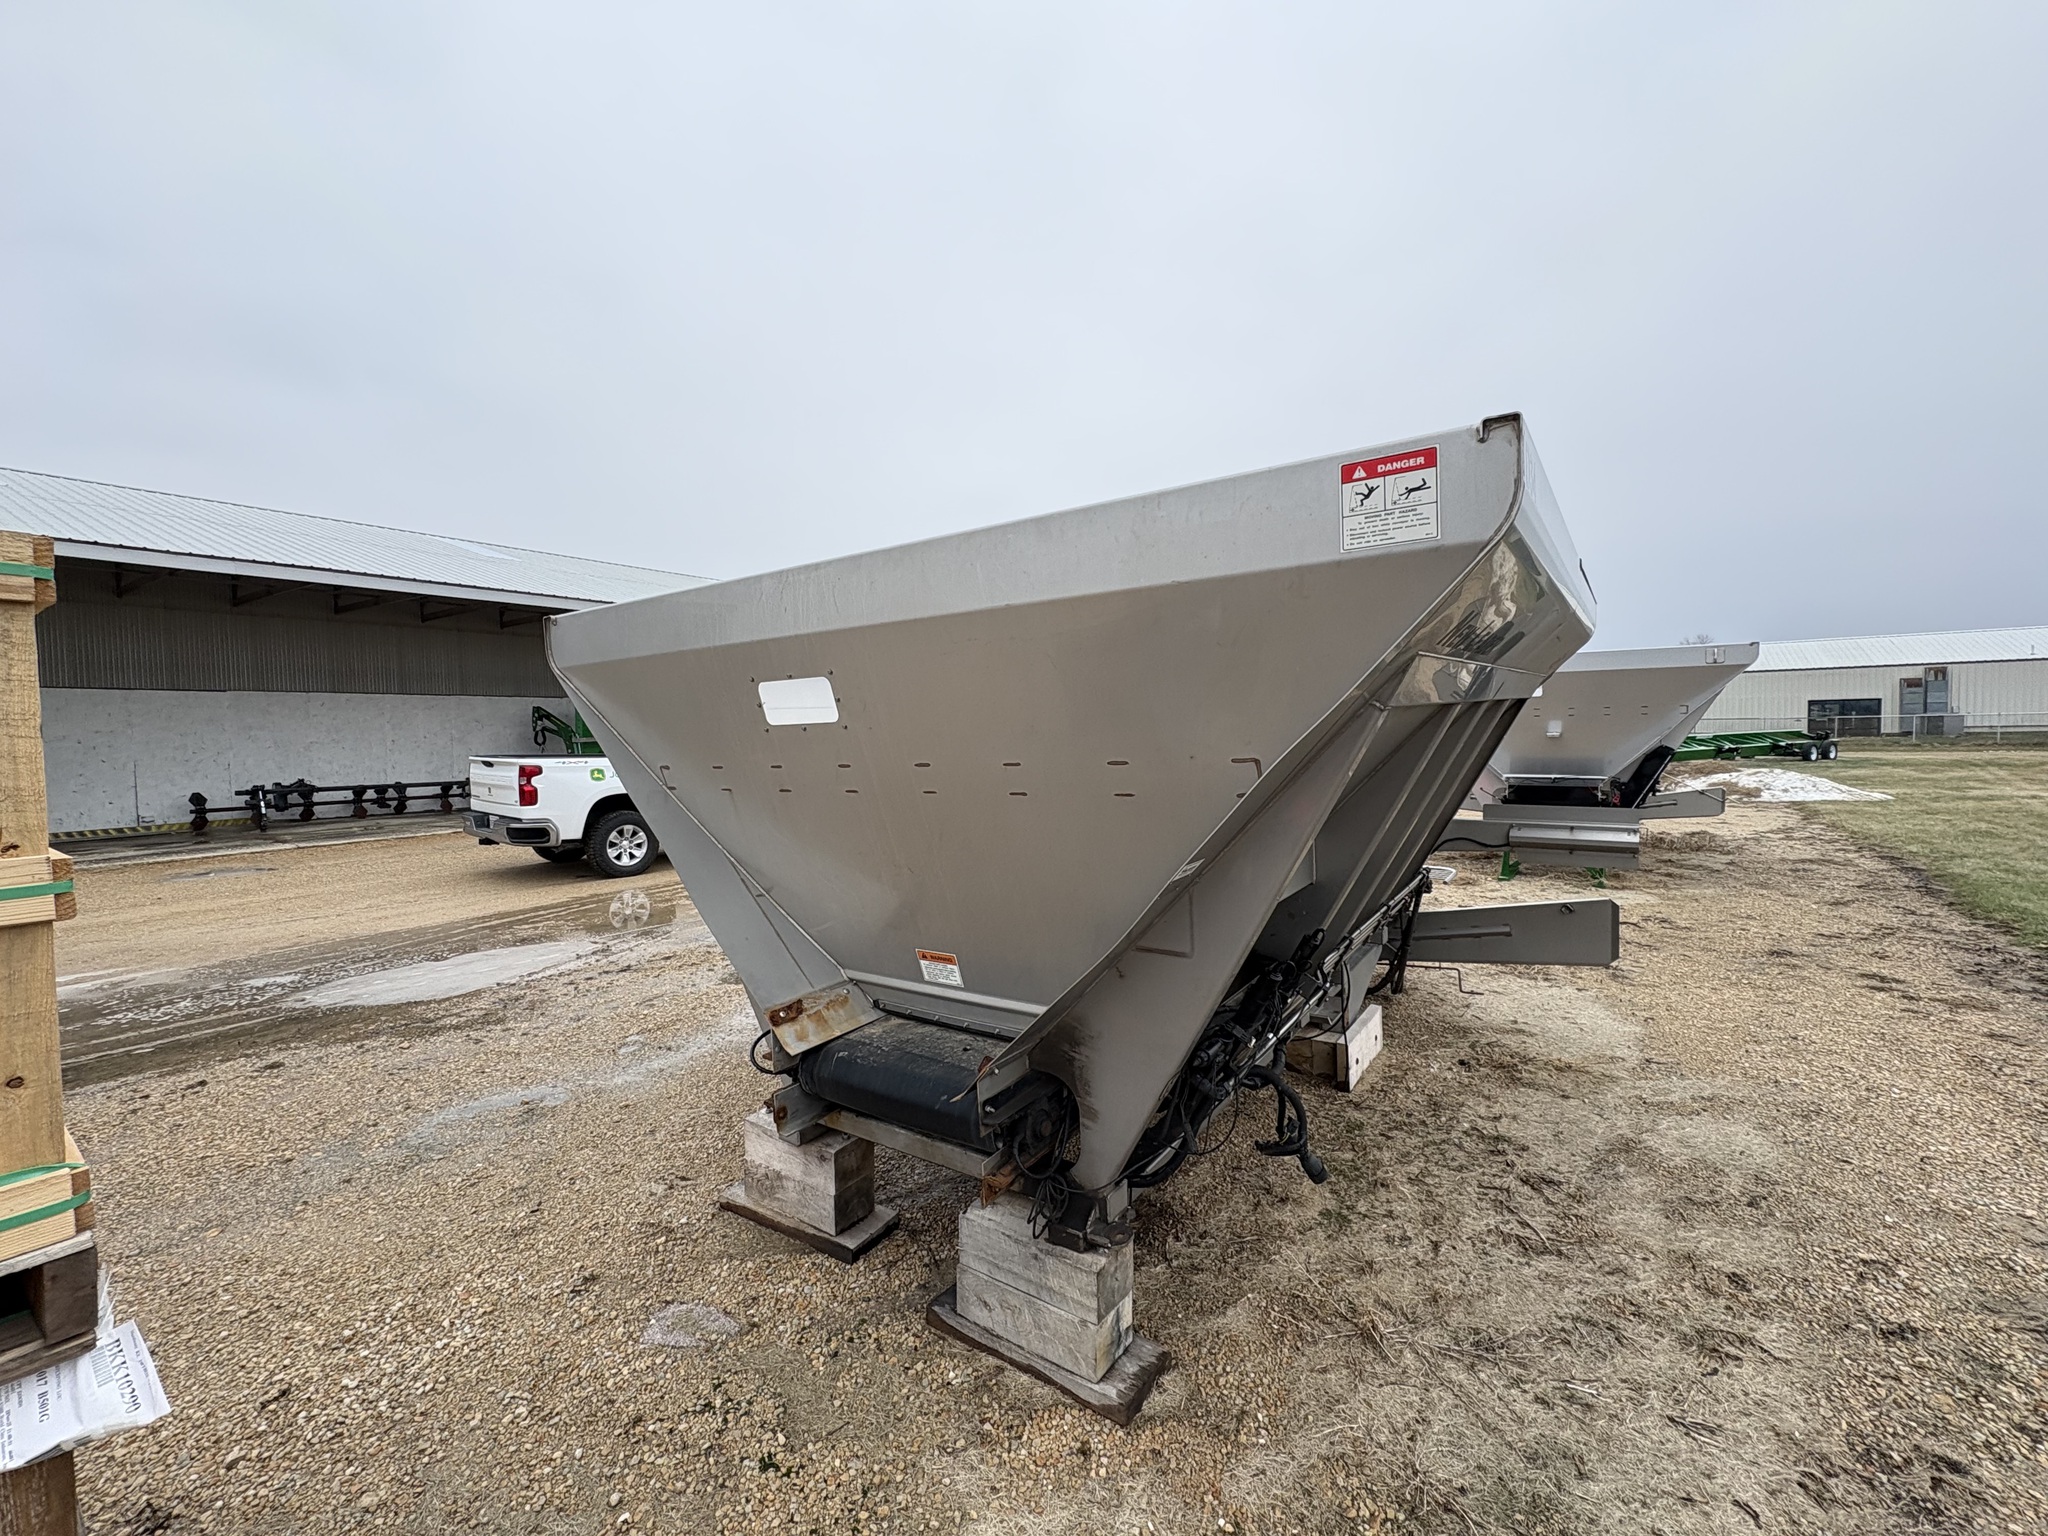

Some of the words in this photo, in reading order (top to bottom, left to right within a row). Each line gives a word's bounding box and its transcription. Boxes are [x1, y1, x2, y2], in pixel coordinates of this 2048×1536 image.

[1377, 456, 1425, 473] DANGER
[104, 1337, 142, 1414] BKK10290
[37, 1390, 50, 1424] B501G
